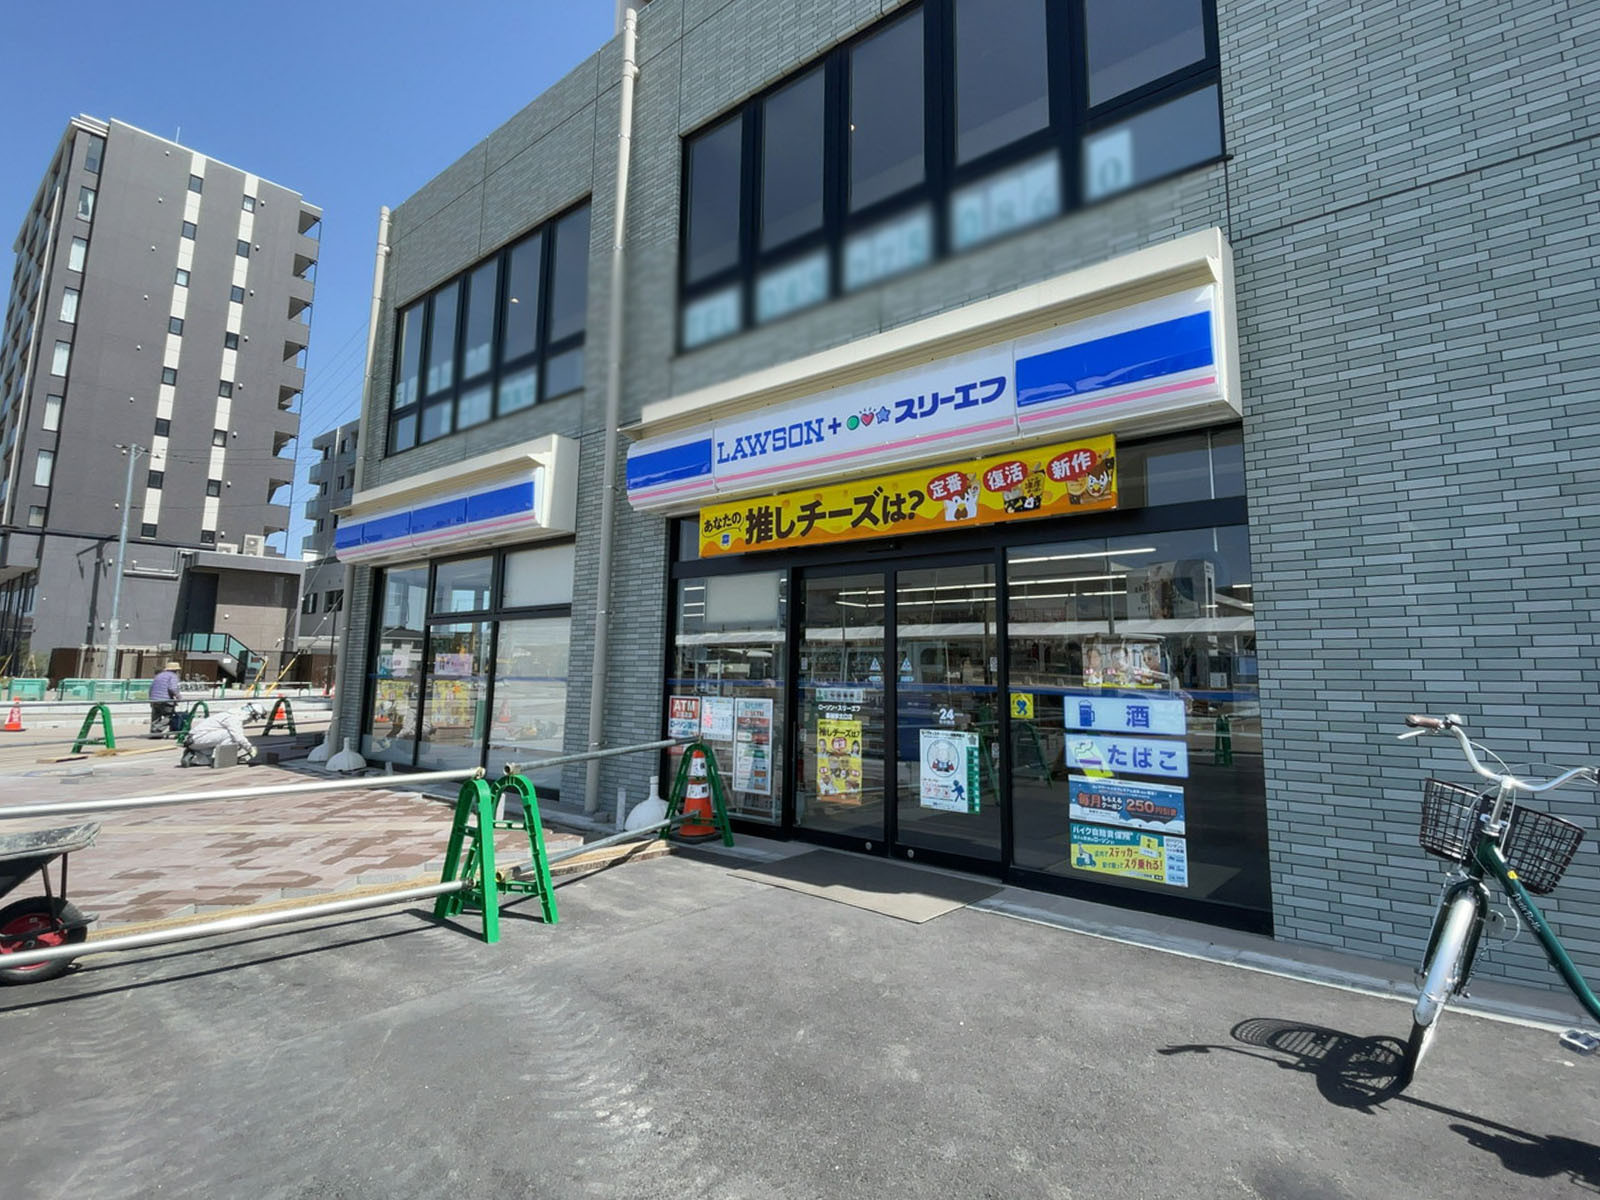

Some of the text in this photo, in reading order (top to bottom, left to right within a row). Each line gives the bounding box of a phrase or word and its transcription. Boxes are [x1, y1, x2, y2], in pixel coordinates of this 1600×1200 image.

[716, 417, 825, 464] LAWSON
[895, 376, 1007, 424] スリーエフ
[987, 463, 1024, 491] 復活
[1051, 452, 1091, 480] 新作
[930, 475, 963, 500] 定番
[703, 511, 742, 533] あなたの
[673, 699, 696, 711] ATM
[939, 708, 954, 721] 24
[1126, 705, 1149, 728] 酒
[1108, 745, 1178, 771] たばこ
